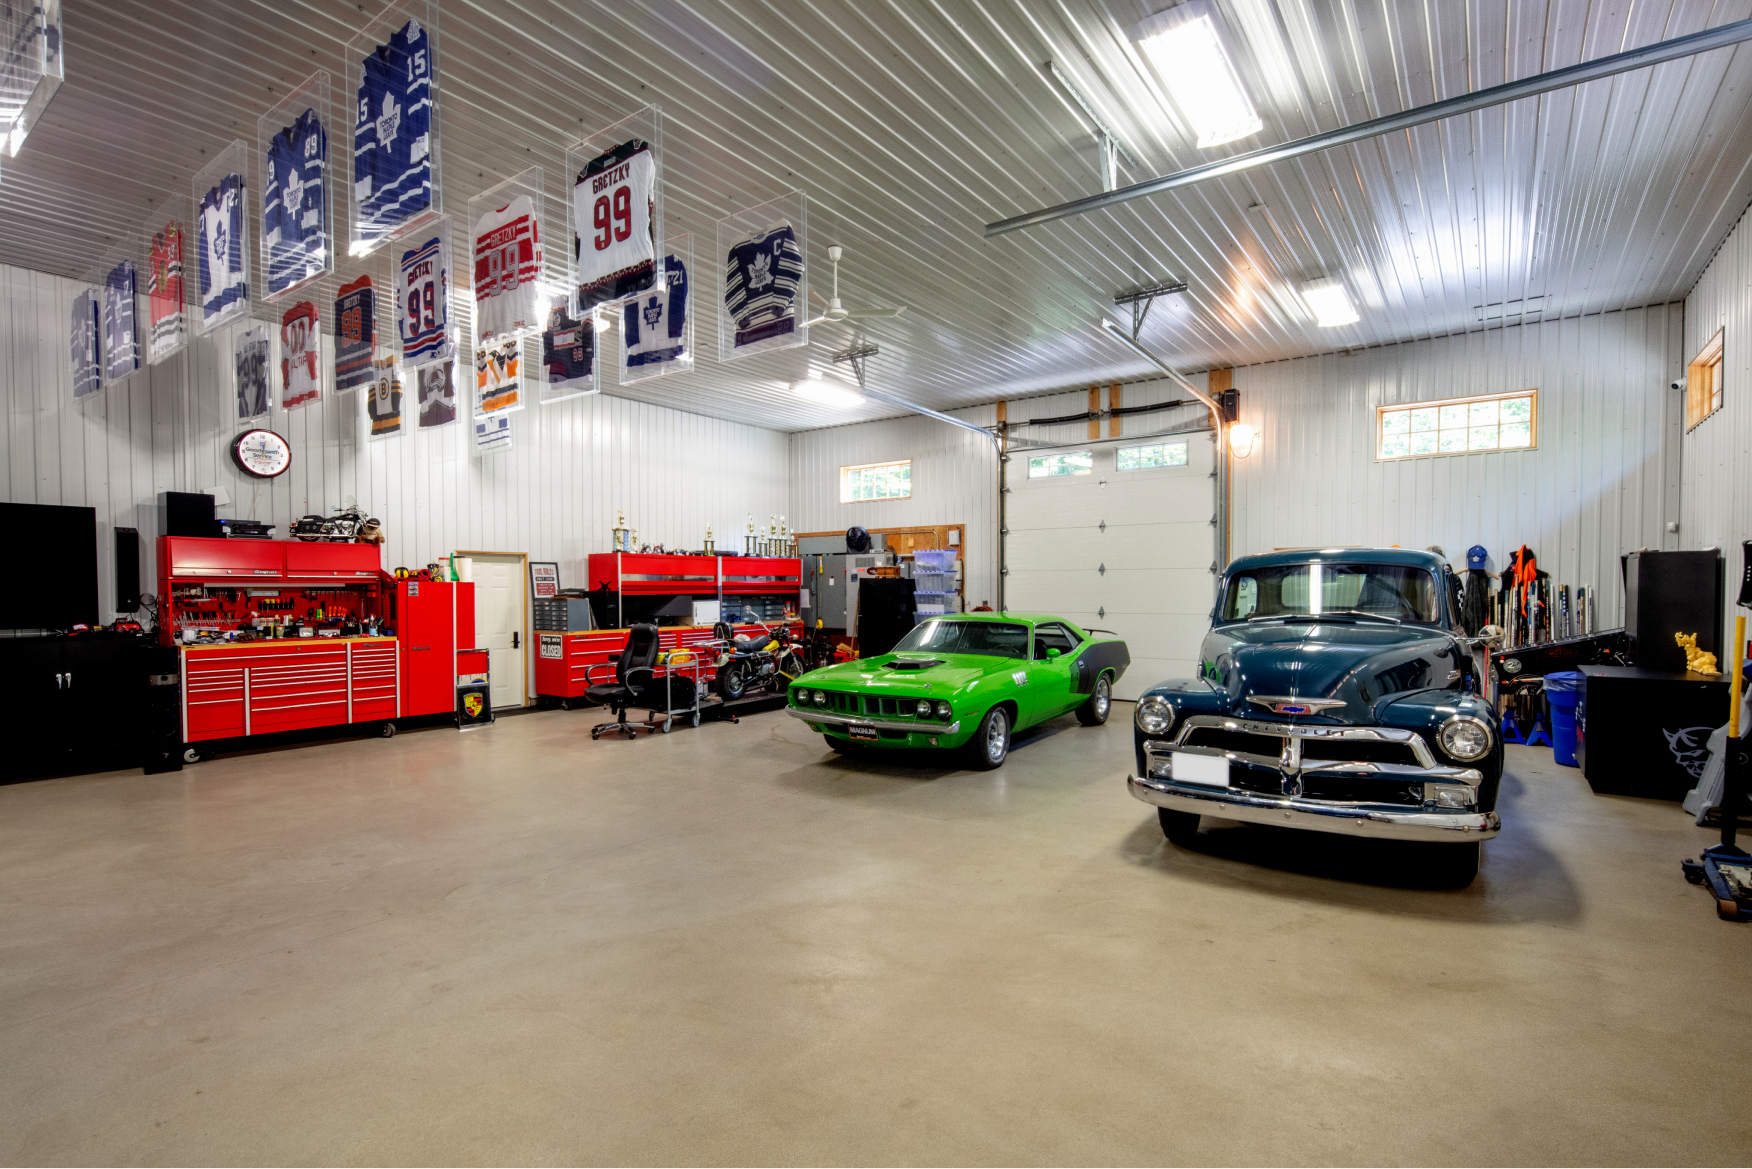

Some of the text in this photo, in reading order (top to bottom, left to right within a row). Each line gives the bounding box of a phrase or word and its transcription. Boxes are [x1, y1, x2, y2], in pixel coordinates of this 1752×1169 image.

[407, 49, 426, 82] 15
[380, 112, 398, 128] TORONTO
[383, 121, 395, 134] MAPLE
[304, 133, 318, 159] 89
[592, 161, 630, 195] GRETZKY
[286, 187, 302, 199] TORONTO
[593, 185, 632, 251] 99
[490, 224, 518, 247] GRETZKY
[773, 238, 781, 256] C
[488, 241, 520, 298] 99
[751, 261, 768, 275] TORONTO
[754, 271, 766, 280] MAPLE
[672, 269, 684, 286] 21
[407, 280, 436, 337] 99
[645, 307, 660, 315] TORONTO
[341, 305, 362, 348] 99
[541, 644, 561, 657] CLOSED
[850, 726, 876, 735] MAGNUM
